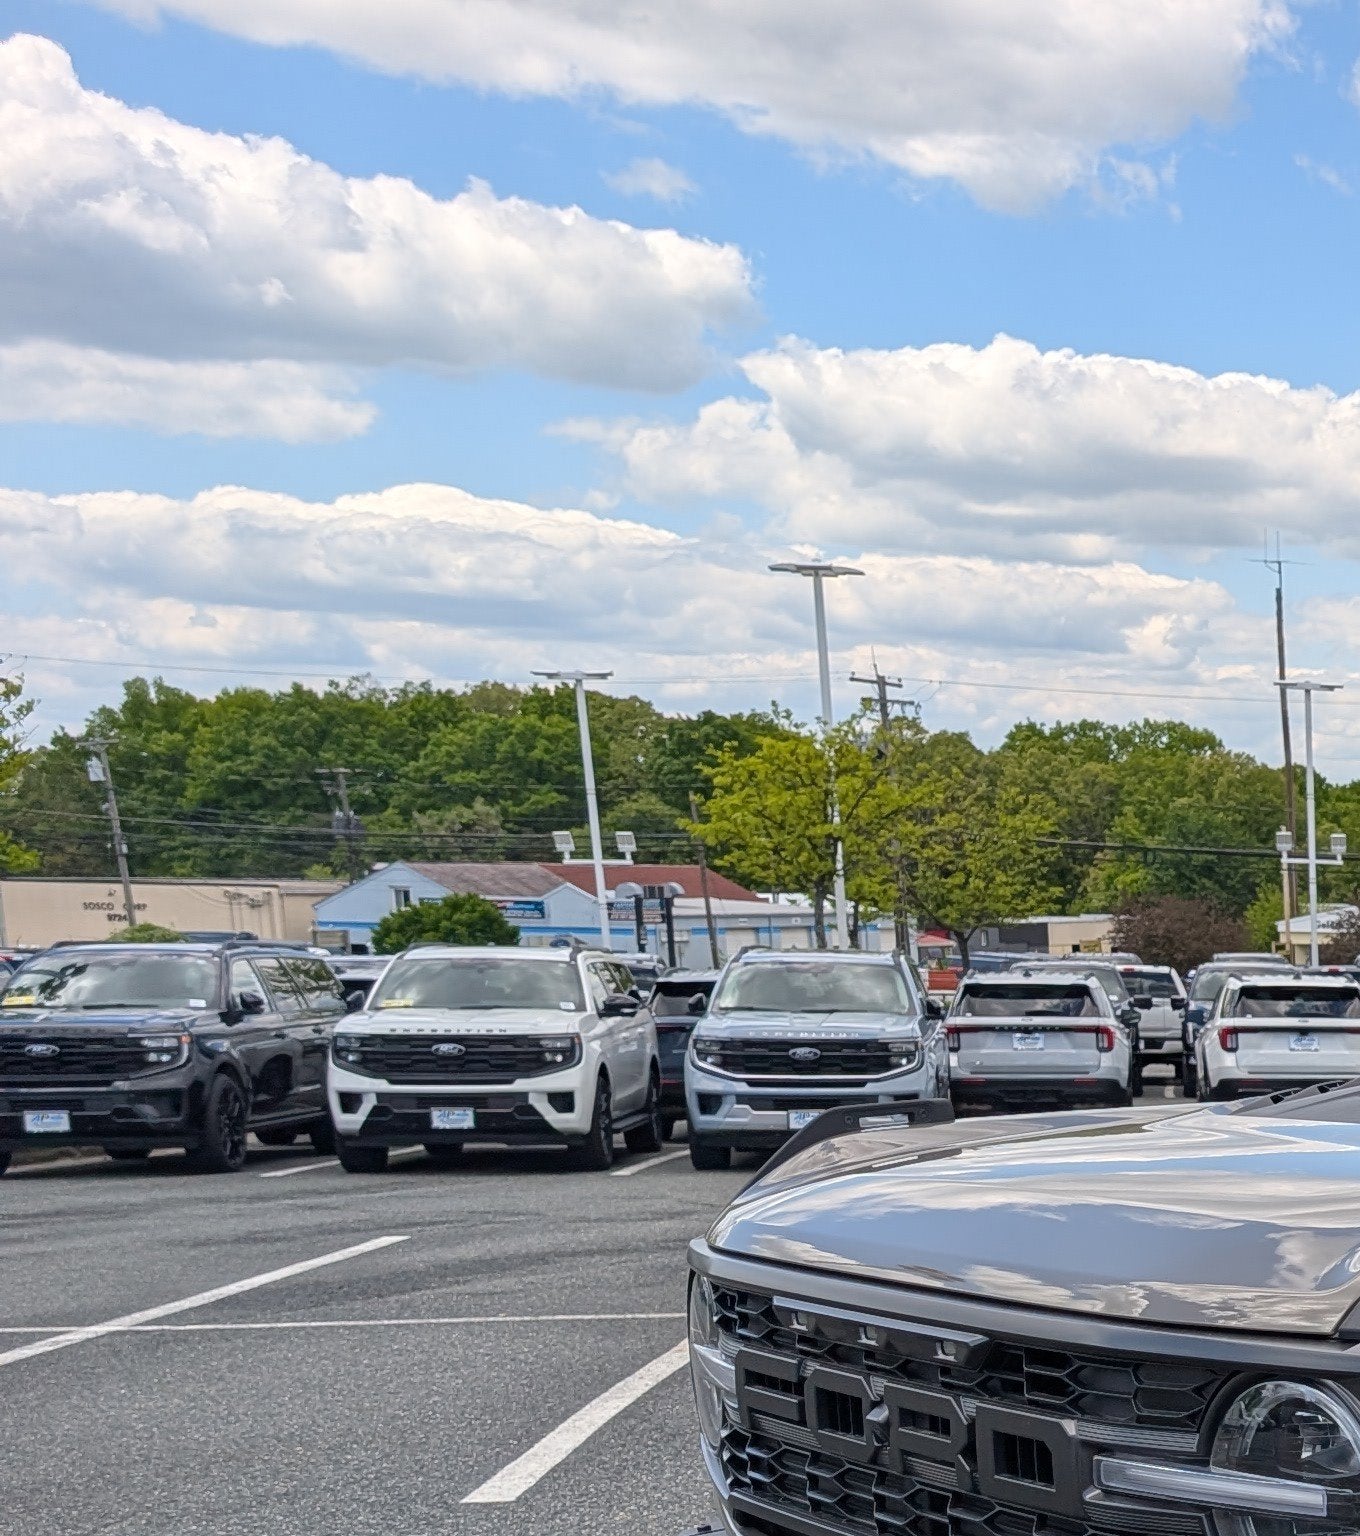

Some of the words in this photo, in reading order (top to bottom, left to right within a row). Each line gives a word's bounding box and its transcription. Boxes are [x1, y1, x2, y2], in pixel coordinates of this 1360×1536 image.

[83, 902, 114, 911] SOSCO
[122, 902, 147, 911] CRP
[733, 1346, 1084, 1518] FORD
